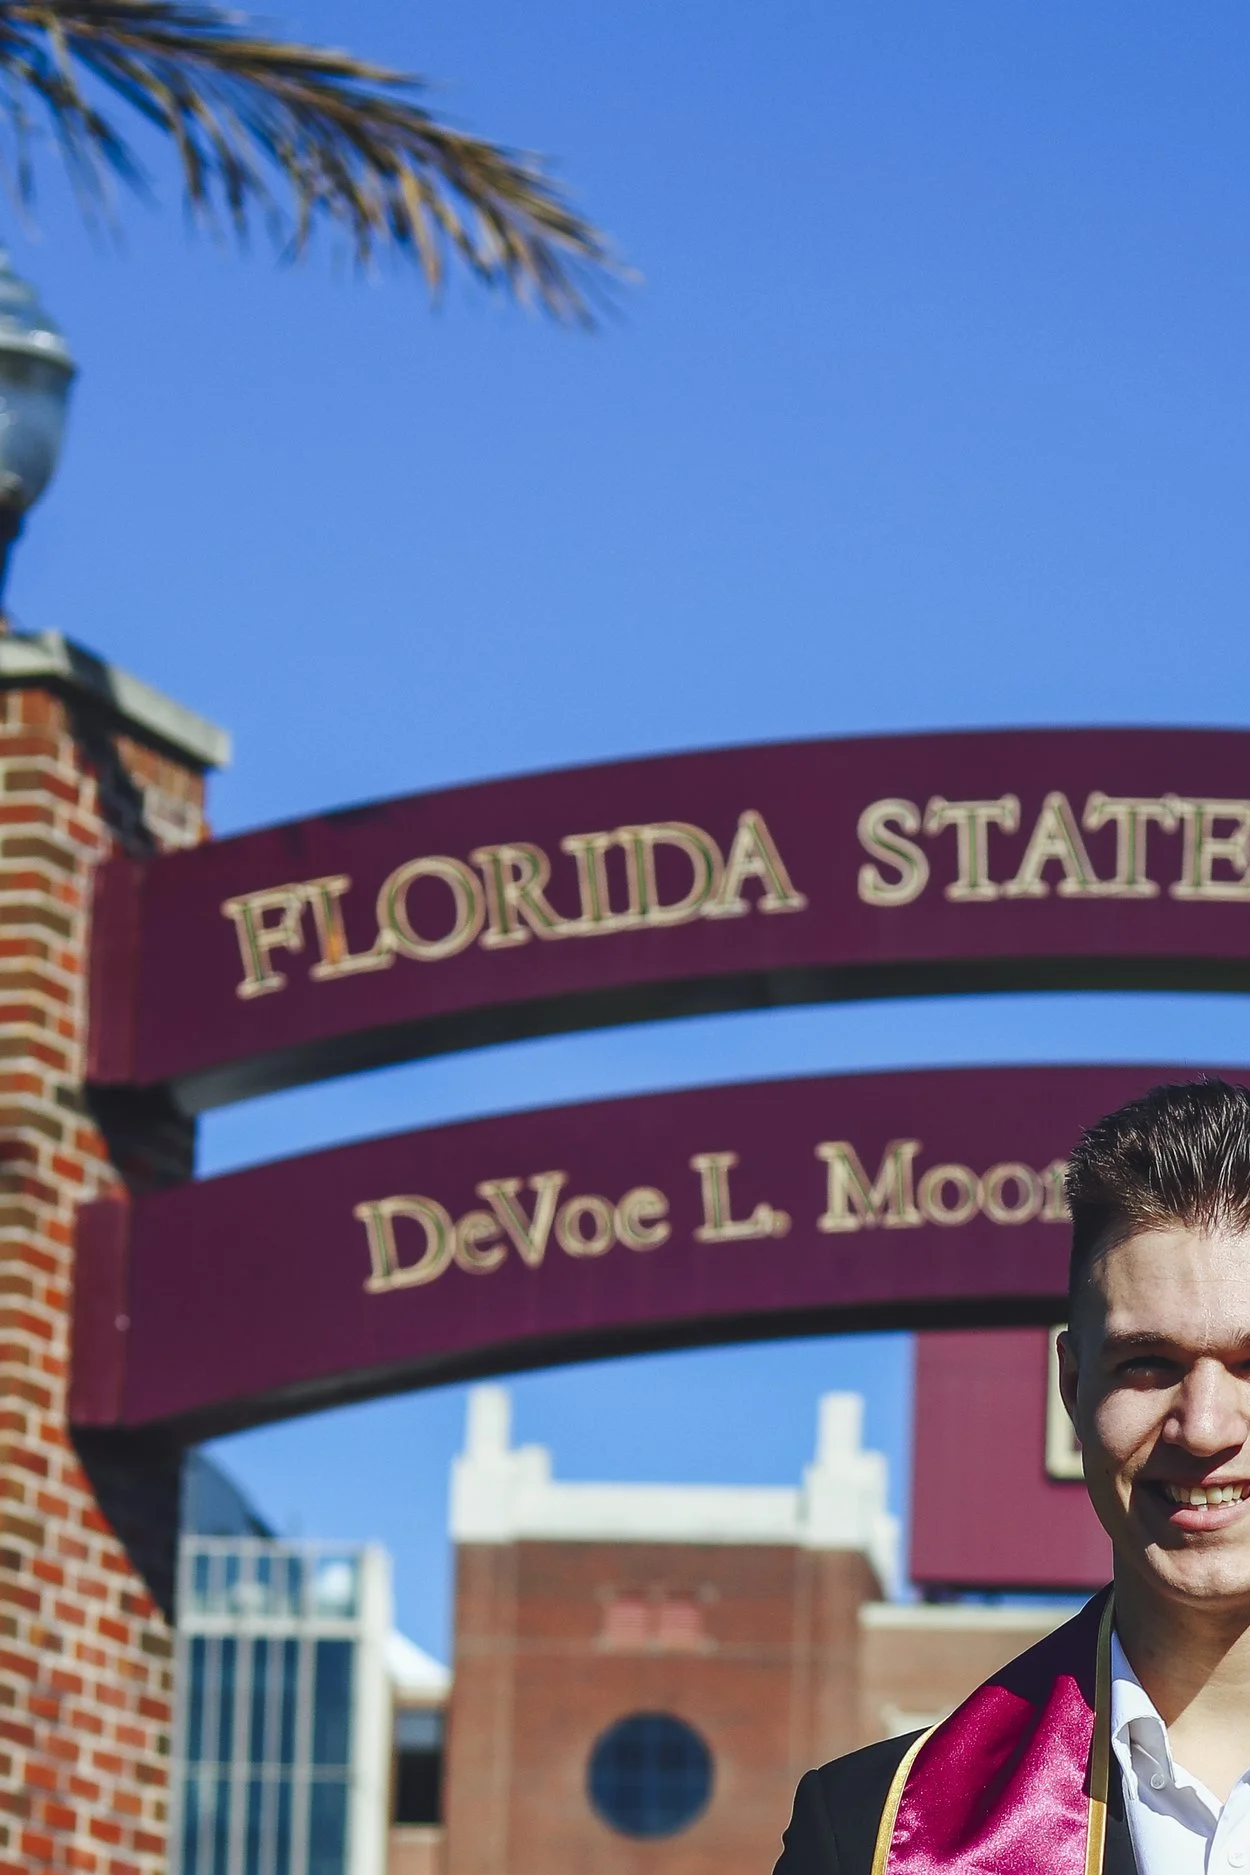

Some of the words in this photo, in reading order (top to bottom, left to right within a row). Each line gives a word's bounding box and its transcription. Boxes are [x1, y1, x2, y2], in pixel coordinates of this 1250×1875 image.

[222, 810, 806, 998] FLORIDA
[355, 1170, 670, 1294] DeVoe
[692, 1152, 790, 1243] L.
